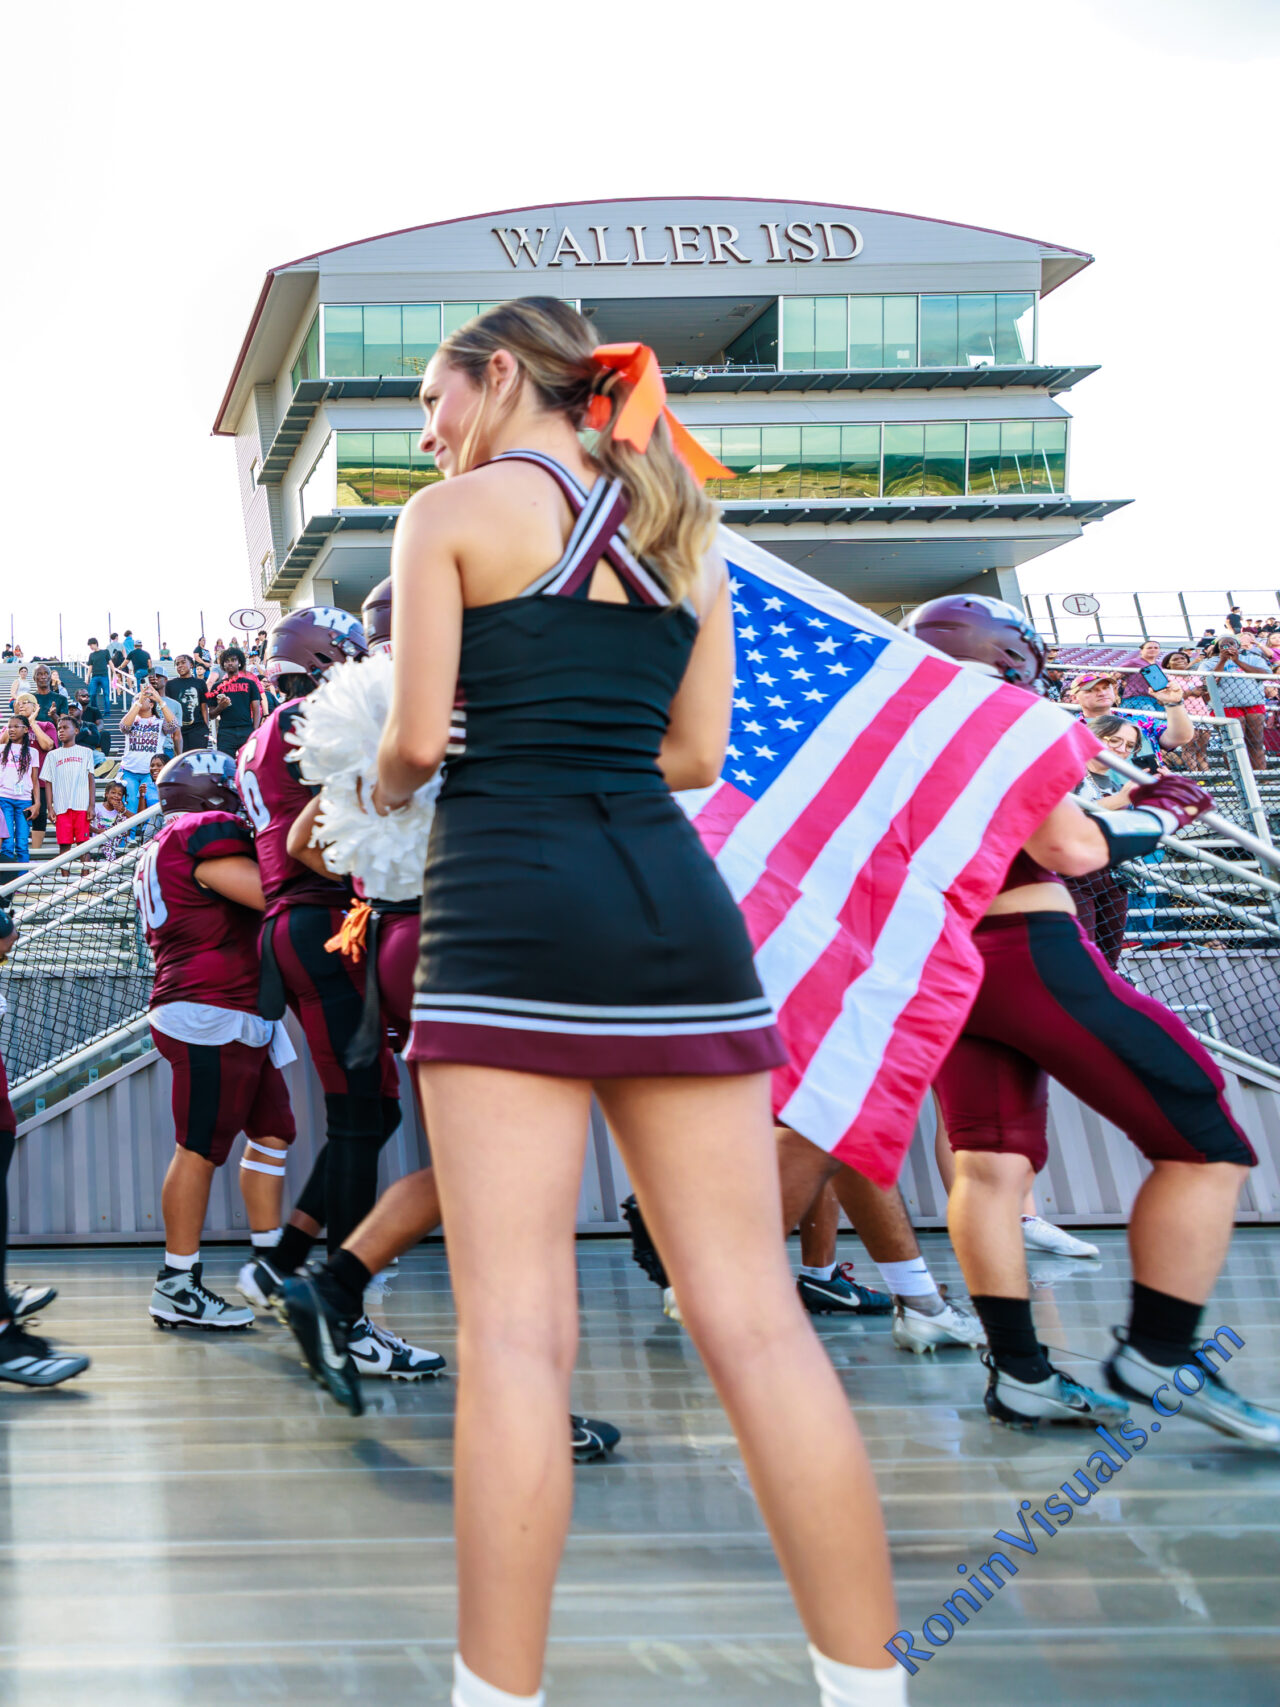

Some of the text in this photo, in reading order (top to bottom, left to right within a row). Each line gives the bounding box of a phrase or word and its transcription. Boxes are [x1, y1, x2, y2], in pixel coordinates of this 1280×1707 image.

[492, 221, 864, 267] WALLER ISD
[1073, 596, 1091, 613] E
[239, 611, 255, 628] C
[221, 682, 249, 694] SCARFACE
[184, 754, 227, 776] W
